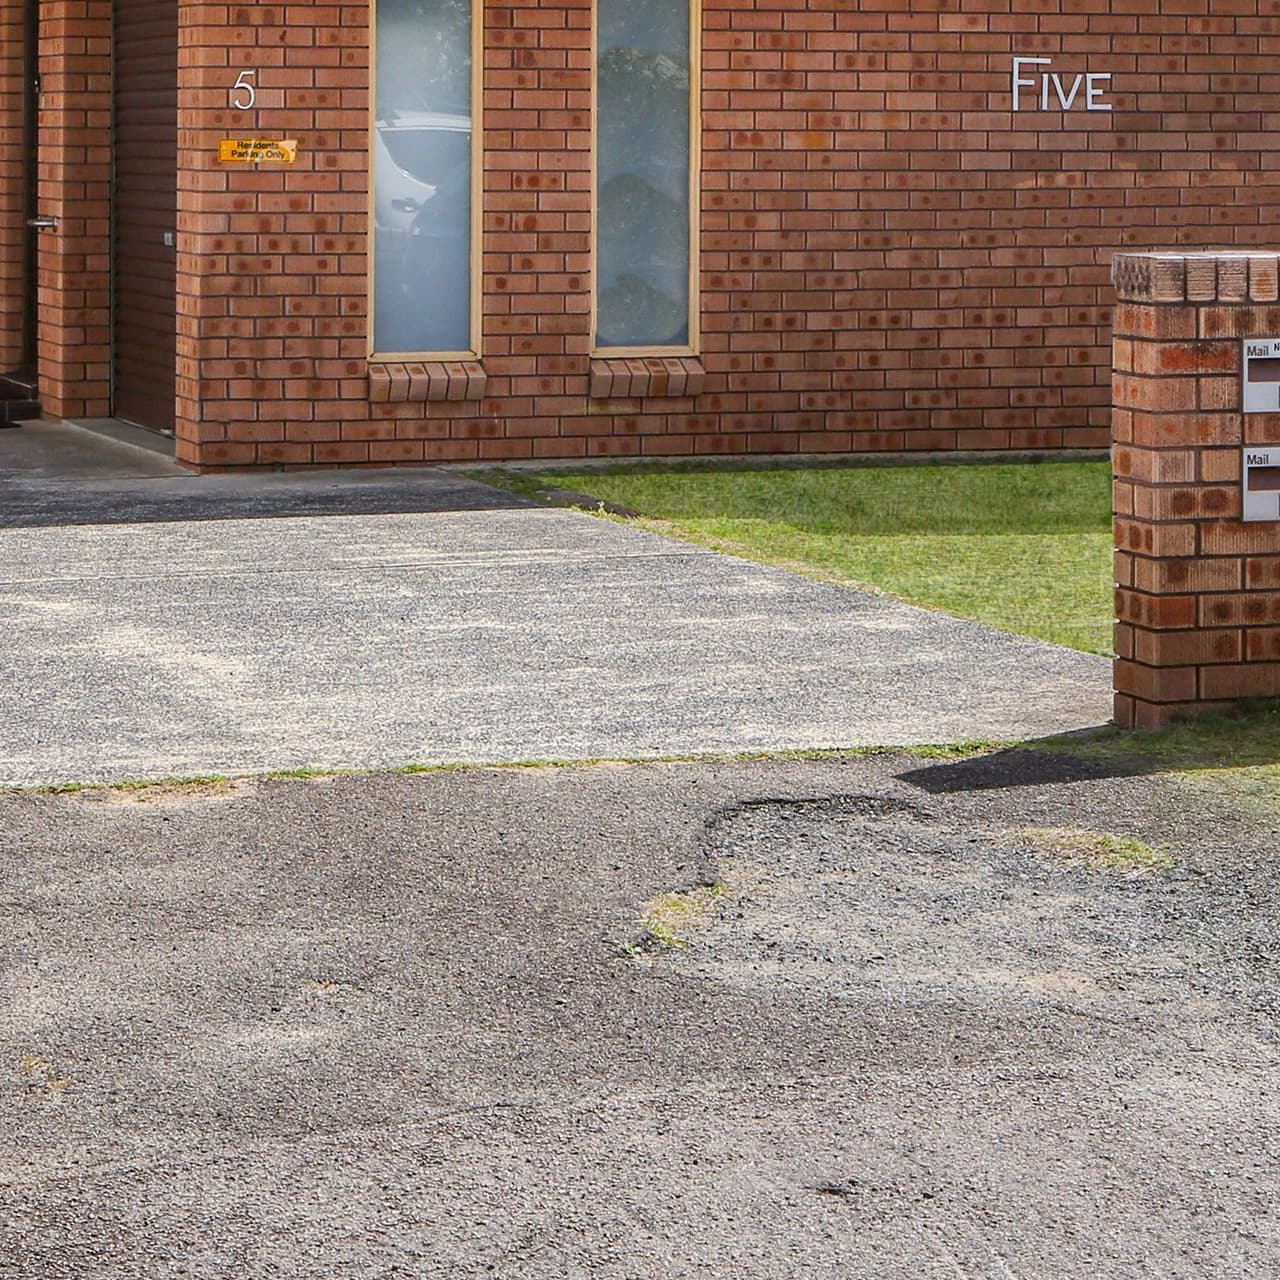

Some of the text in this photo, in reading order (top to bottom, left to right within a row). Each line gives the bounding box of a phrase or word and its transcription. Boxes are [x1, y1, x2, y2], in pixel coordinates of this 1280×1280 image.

[234, 70, 255, 109] 5
[265, 150, 286, 160] Only
[1247, 346, 1269, 356] Mail
[1247, 454, 1269, 465] Mail
